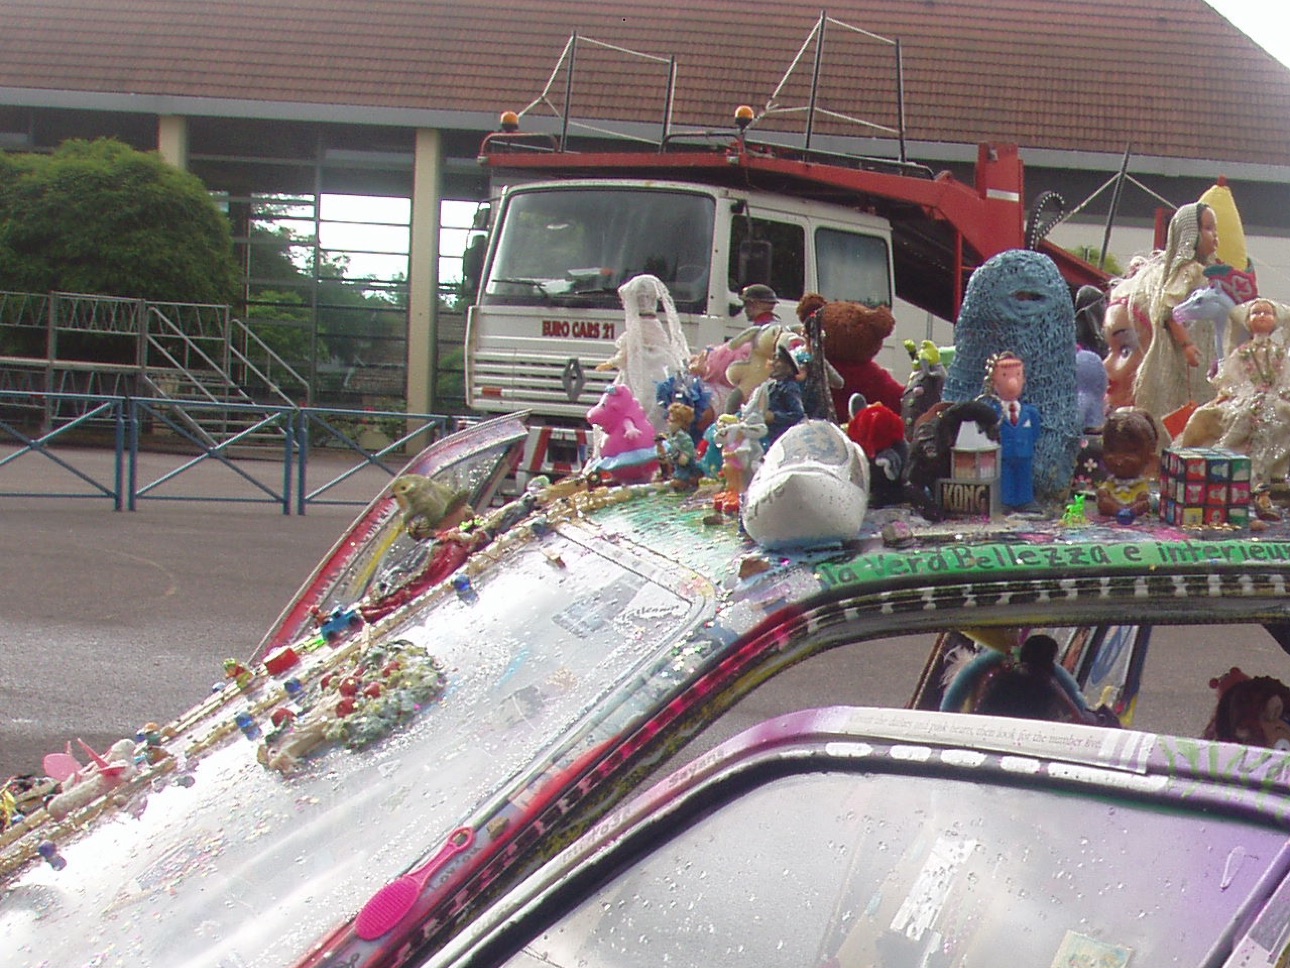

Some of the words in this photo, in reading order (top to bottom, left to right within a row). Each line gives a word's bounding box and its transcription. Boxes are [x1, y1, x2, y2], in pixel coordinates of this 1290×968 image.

[542, 320, 570, 337] EURO
[572, 321, 600, 339] CARS
[602, 322, 615, 339] 21
[941, 483, 988, 512] KONG
